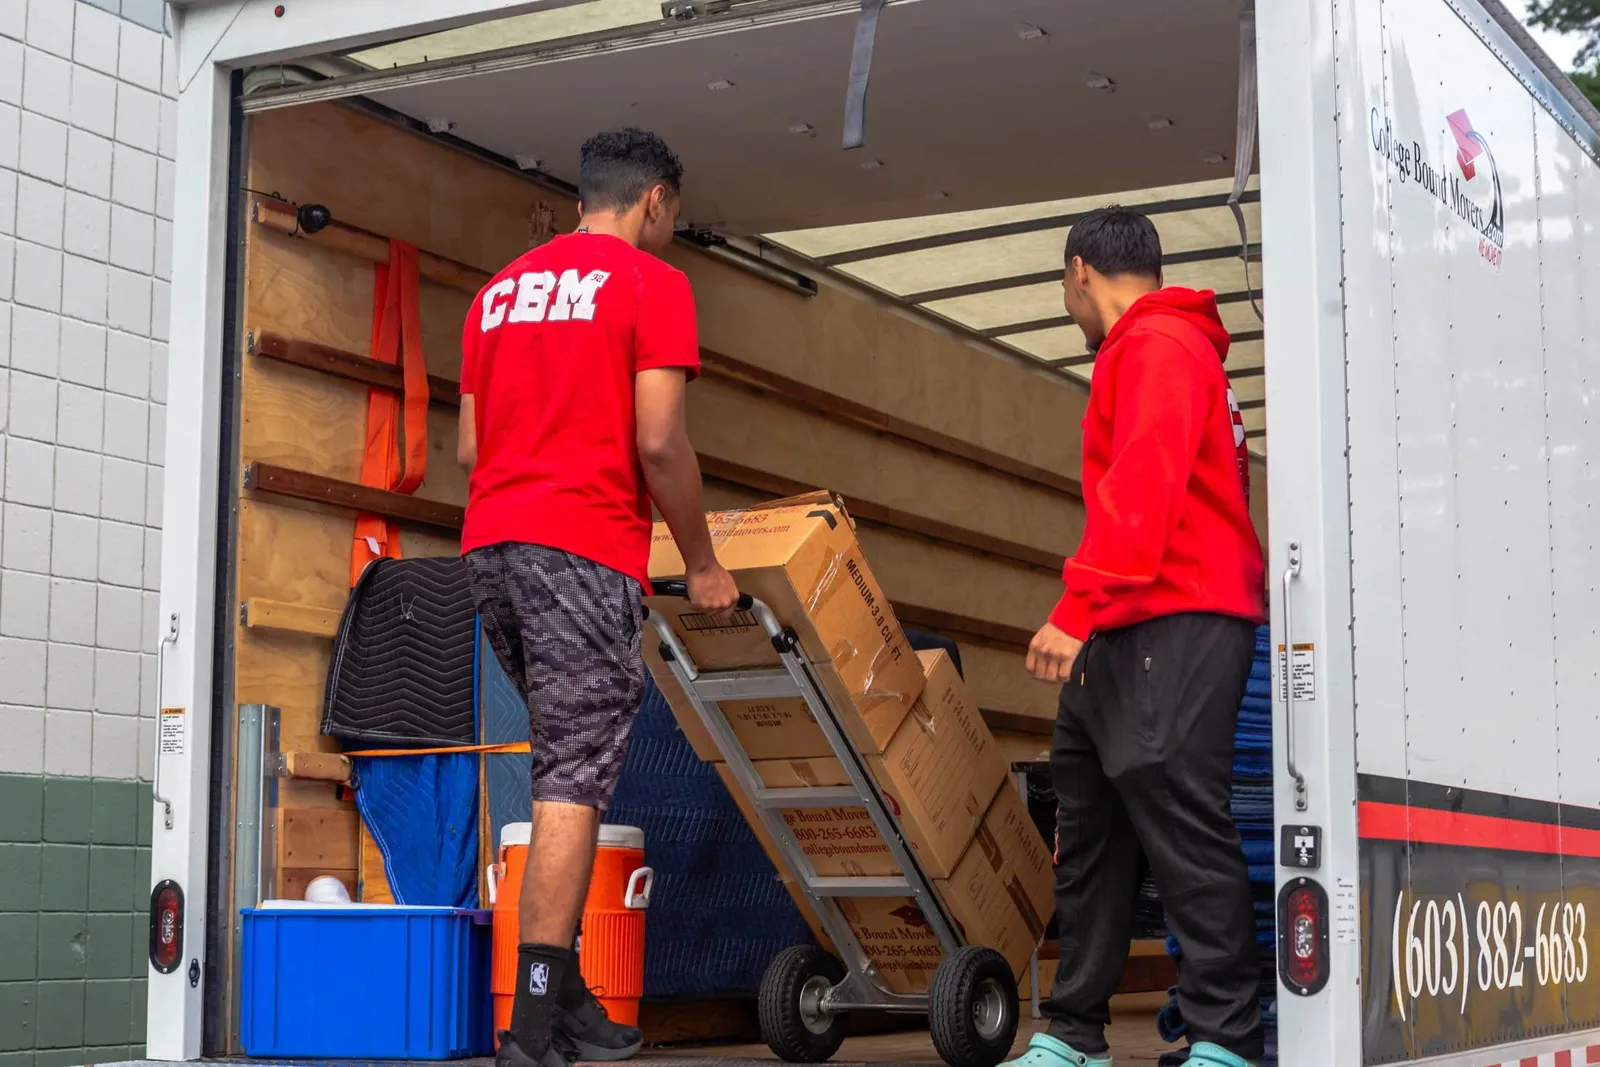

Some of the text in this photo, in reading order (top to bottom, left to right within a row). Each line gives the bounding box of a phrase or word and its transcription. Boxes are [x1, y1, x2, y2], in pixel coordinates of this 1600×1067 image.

[1370, 106, 1485, 233] College Bound Movers
[480, 268, 612, 333] CBM
[794, 809, 832, 823] Bound
[834, 806, 871, 820] Mover
[860, 926, 898, 940] Bound
[898, 926, 932, 940] Move
[862, 944, 942, 957] 00-265-6683
[1392, 889, 1470, 1022] (603)
[1476, 900, 1588, 992] 882-6683
